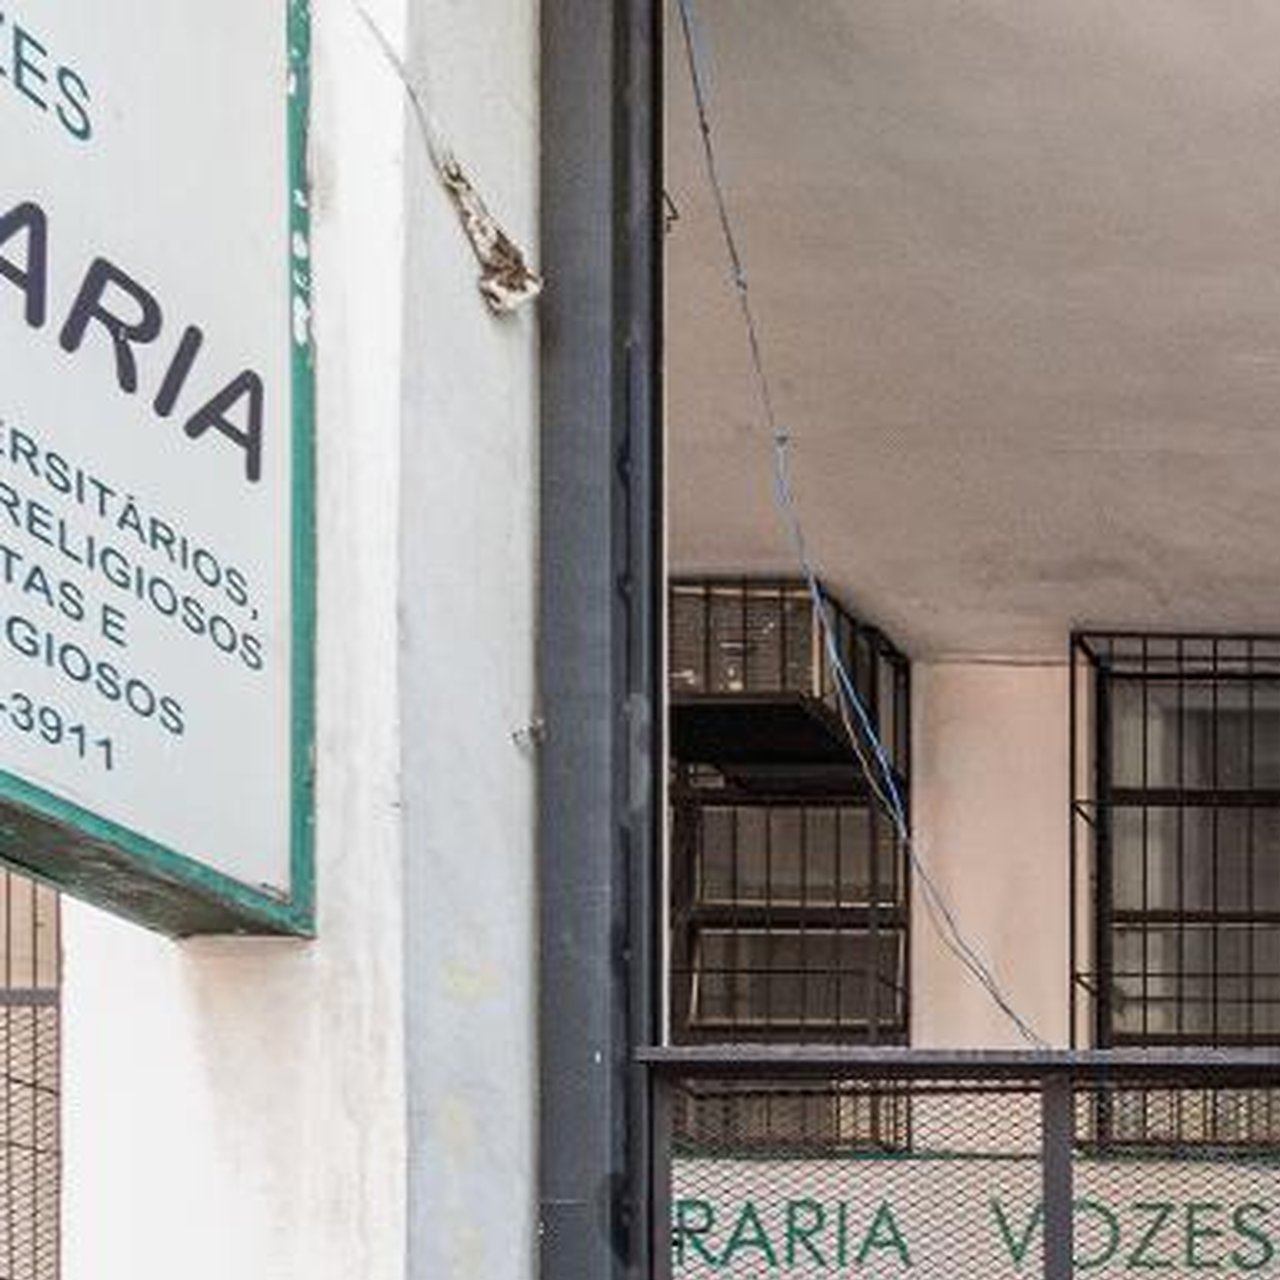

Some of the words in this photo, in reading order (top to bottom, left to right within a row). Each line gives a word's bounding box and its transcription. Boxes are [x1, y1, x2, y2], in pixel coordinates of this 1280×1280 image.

[0, 12, 91, 140] ES
[0, 420, 258, 621] RSITÁRIOS,
[6, 616, 184, 734] GIOSOS
[103, 604, 127, 647] E
[676, 1200, 912, 1270] RARIA
